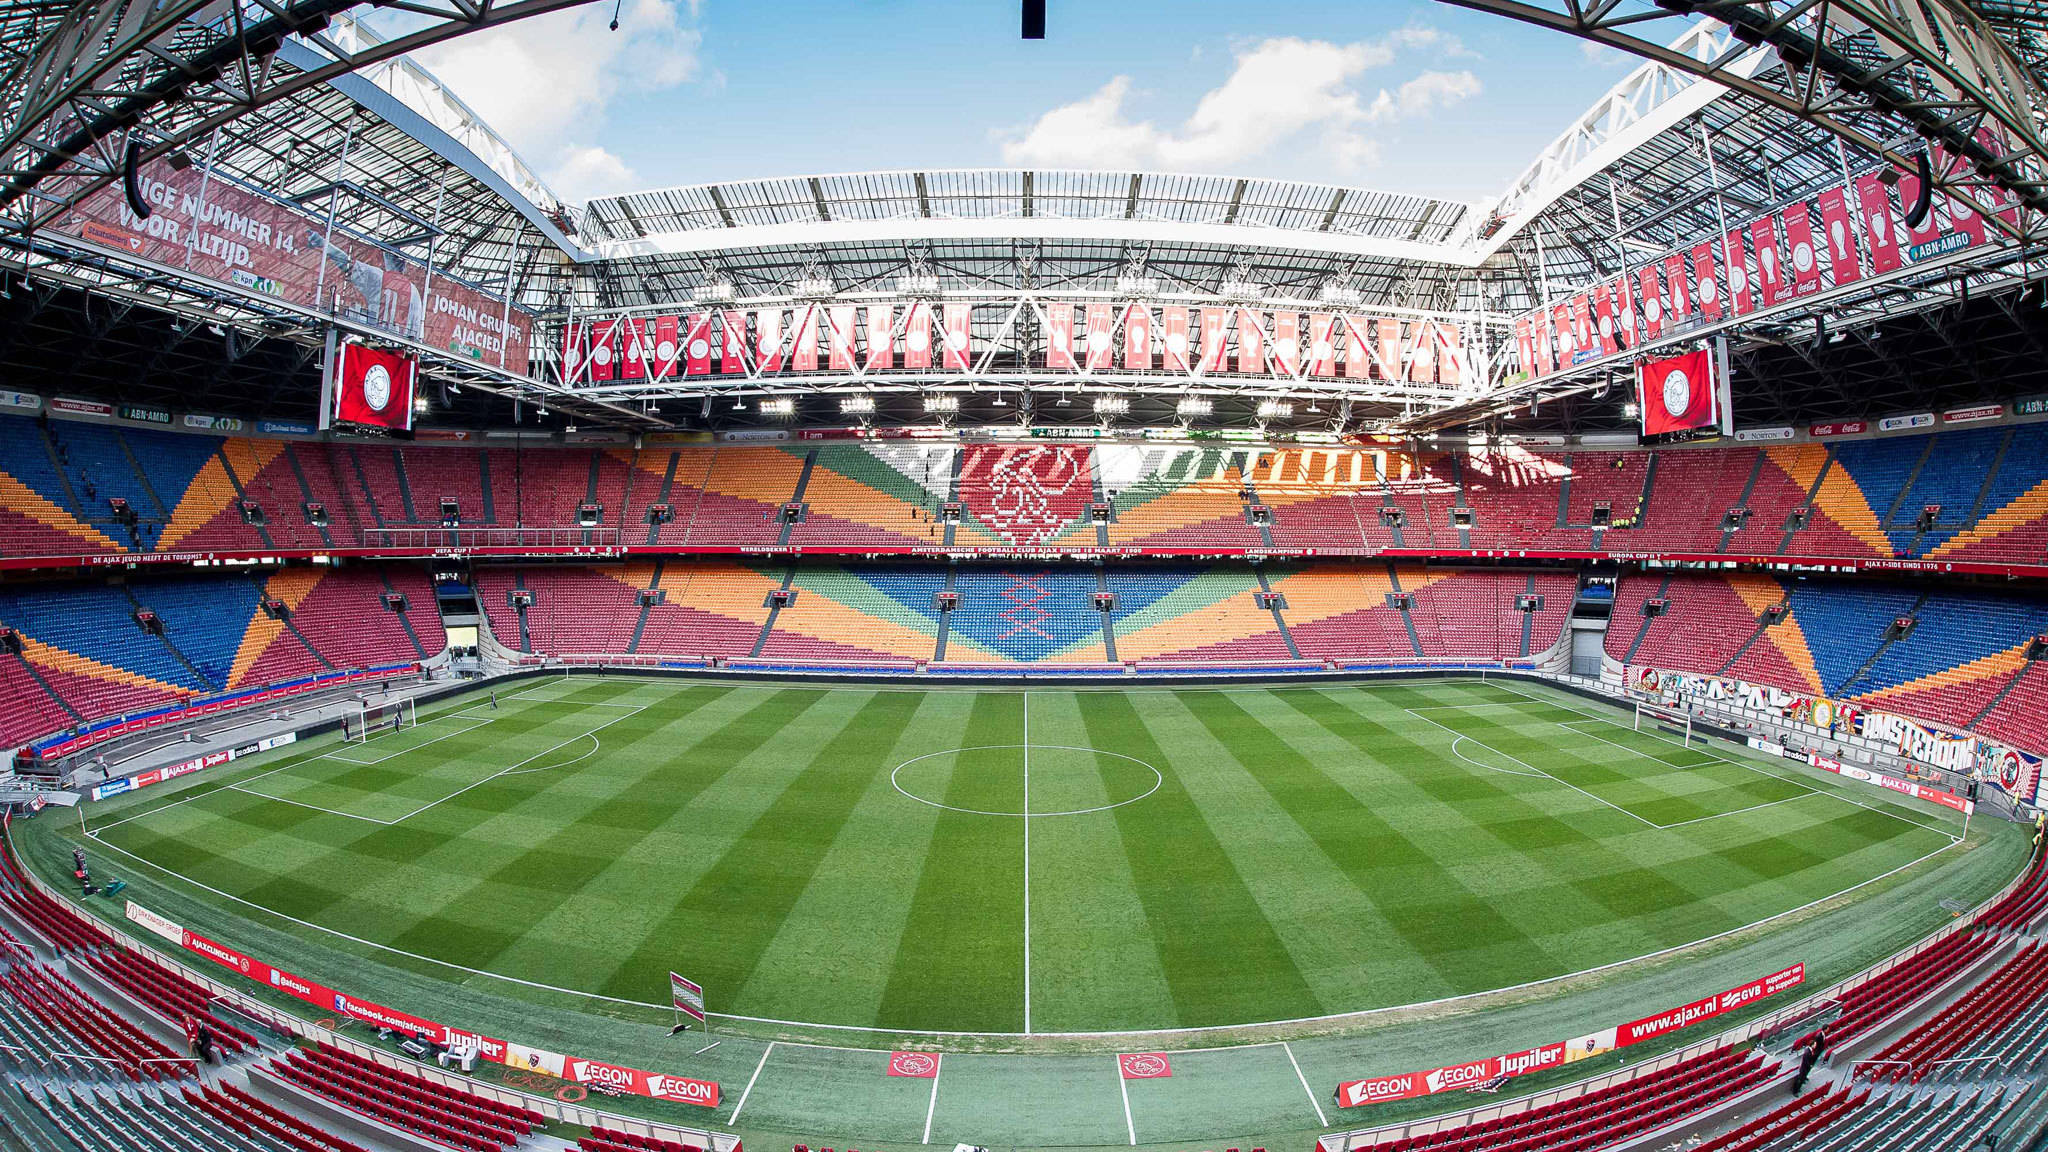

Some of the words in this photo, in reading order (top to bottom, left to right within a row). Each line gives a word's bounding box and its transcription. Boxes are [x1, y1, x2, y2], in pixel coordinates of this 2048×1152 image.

[110, 173, 178, 210] IGE
[180, 193, 271, 246] NUMMER
[276, 230, 300, 256] 14.
[119, 202, 180, 244] VOOR
[184, 228, 254, 269] ALTIJD.
[433, 294, 477, 324] JOHAN
[1881, 776, 1911, 792] AJAX.TV
[191, 938, 239, 965] AJAXCLINICS.NL
[281, 976, 311, 994] @afcajax
[1765, 970, 1792, 986] supporter
[1767, 984, 1775, 994] de
[1775, 974, 1801, 991] supporter
[1741, 985, 1761, 1001] GVB
[346, 1002, 437, 1038] facebook.com/afcajax
[1631, 996, 1717, 1038] www.ajax.nl
[440, 1026, 503, 1057] Jupiler
[583, 1062, 633, 1086] AEGON
[1492, 1046, 1562, 1078] Jupiler
[1360, 1076, 1413, 1097] AEGON
[1437, 1063, 1486, 1087] AEGON
[657, 1076, 712, 1099] AEGON
